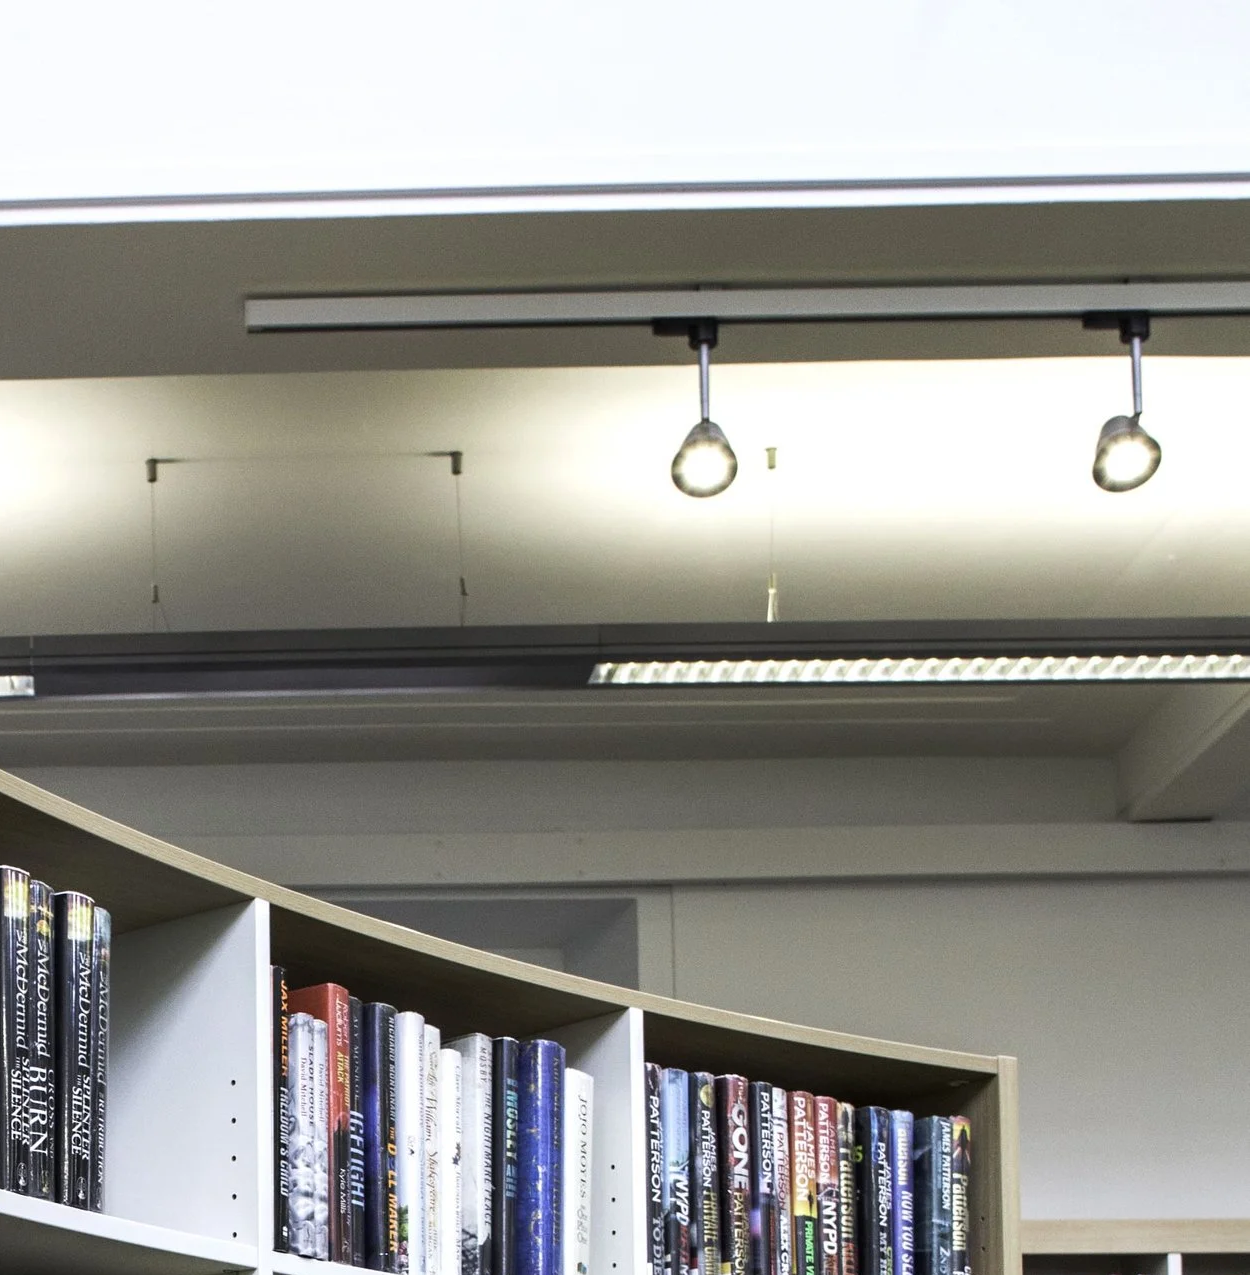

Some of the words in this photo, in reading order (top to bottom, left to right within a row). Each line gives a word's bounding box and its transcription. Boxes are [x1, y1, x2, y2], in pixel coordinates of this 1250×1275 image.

[16, 940, 28, 1048] McDermid
[37, 951, 49, 1056] McDermid
[78, 966, 90, 1066] McDermid
[479, 1046, 487, 1083] MOSBY
[30, 1067, 48, 1153] BURN
[280, 1087, 288, 1153] FREEDOM'S
[507, 1090, 517, 1160] MOSLEY
[578, 1096, 588, 1135] JOJO
[650, 1096, 661, 1202] PATTERSON
[702, 1110, 711, 1188] PATTERSON
[731, 1104, 748, 1191] GONE
[760, 1091, 772, 1184] PATTERSON
[794, 1097, 808, 1199] PATTERSON
[819, 1103, 829, 1183] PATTERSON
[280, 1157, 289, 1196] CHILD
[580, 1140, 588, 1198] MOYES
[878, 1142, 887, 1226] PATTERSON
